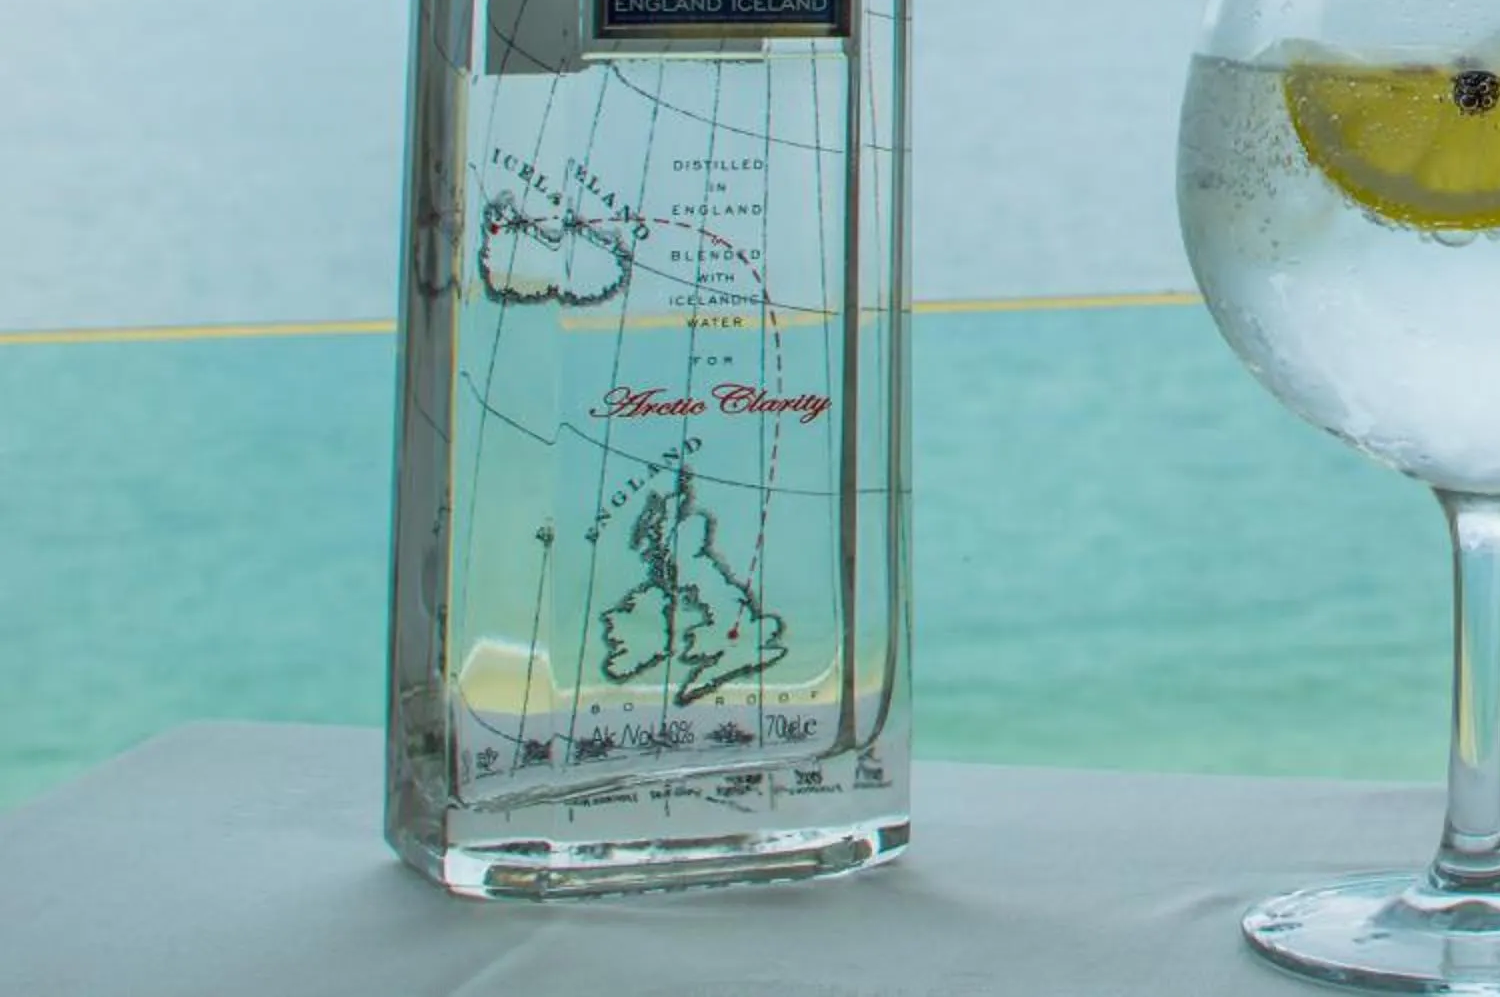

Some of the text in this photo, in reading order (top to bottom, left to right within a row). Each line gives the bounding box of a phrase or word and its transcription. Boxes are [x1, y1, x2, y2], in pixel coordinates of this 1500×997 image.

[673, 159, 764, 172] DISTILLED
[709, 183, 726, 193] IN
[671, 204, 762, 216] ENGLAND
[697, 272, 735, 284] WITH
[669, 294, 760, 306] ICELANDIC
[687, 316, 743, 328] WATER
[693, 356, 733, 367] FOR
[589, 383, 832, 424] Arctic Clarity
